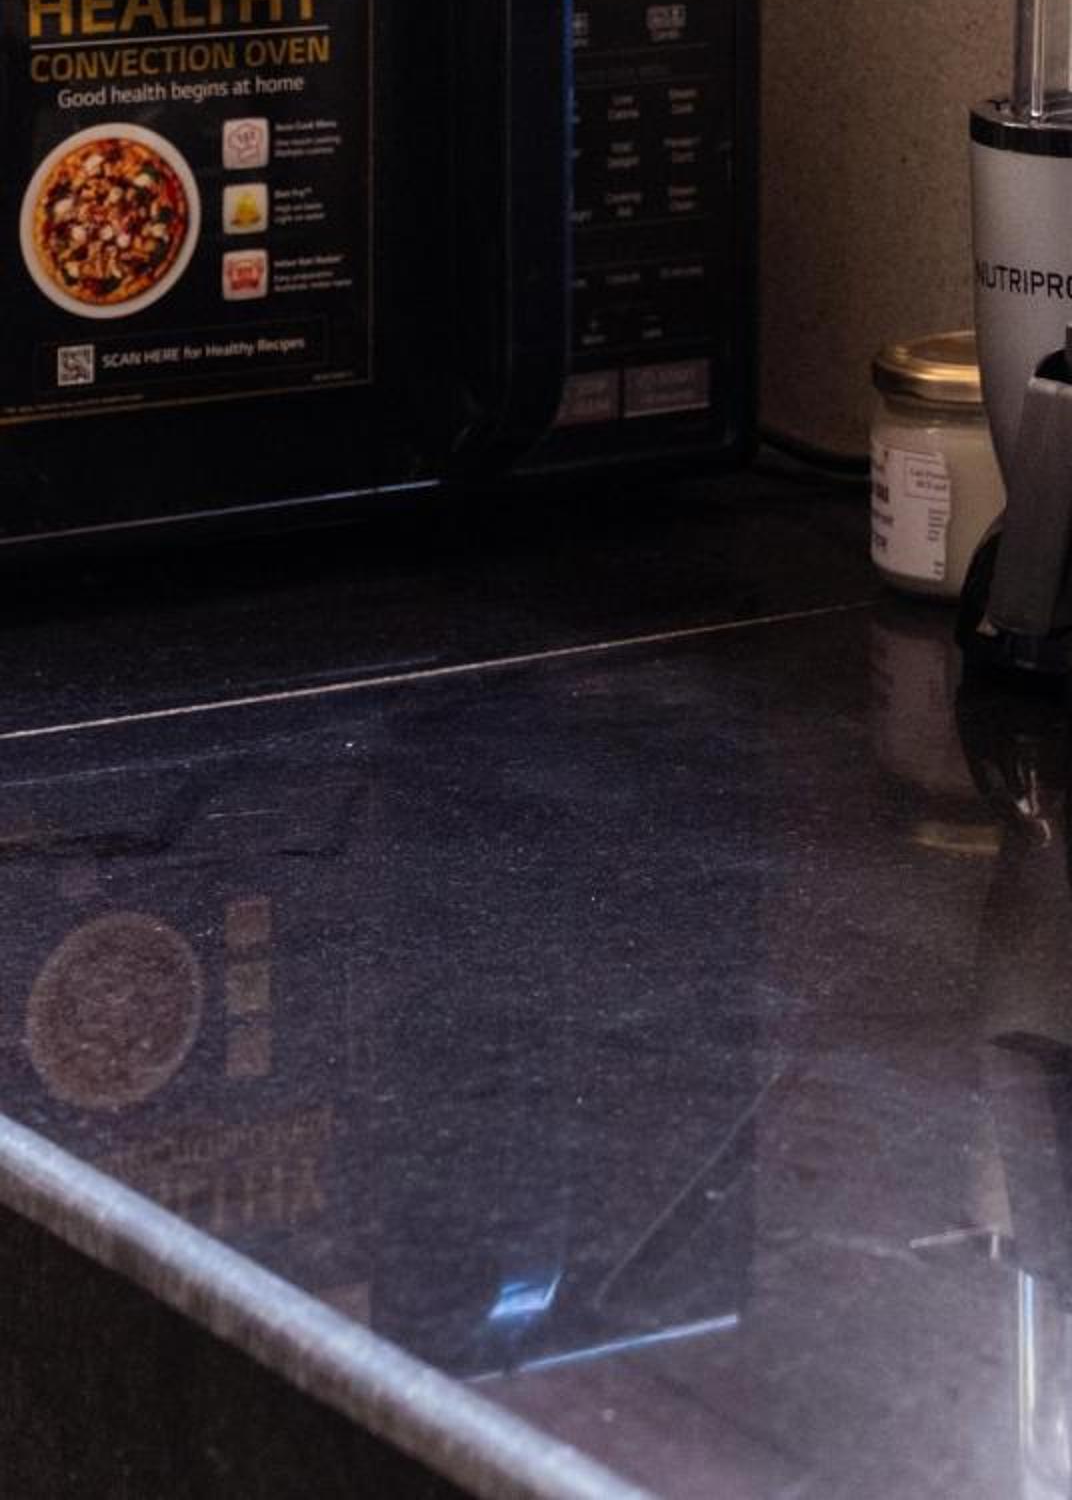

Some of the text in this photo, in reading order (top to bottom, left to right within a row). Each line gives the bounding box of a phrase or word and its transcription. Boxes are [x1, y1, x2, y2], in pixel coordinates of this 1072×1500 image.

[30, 35, 331, 83] CONVECTION OVEN
[57, 75, 304, 109] Good health begins at home
[102, 352, 142, 369] SCAN
[144, 346, 180, 363] HERE
